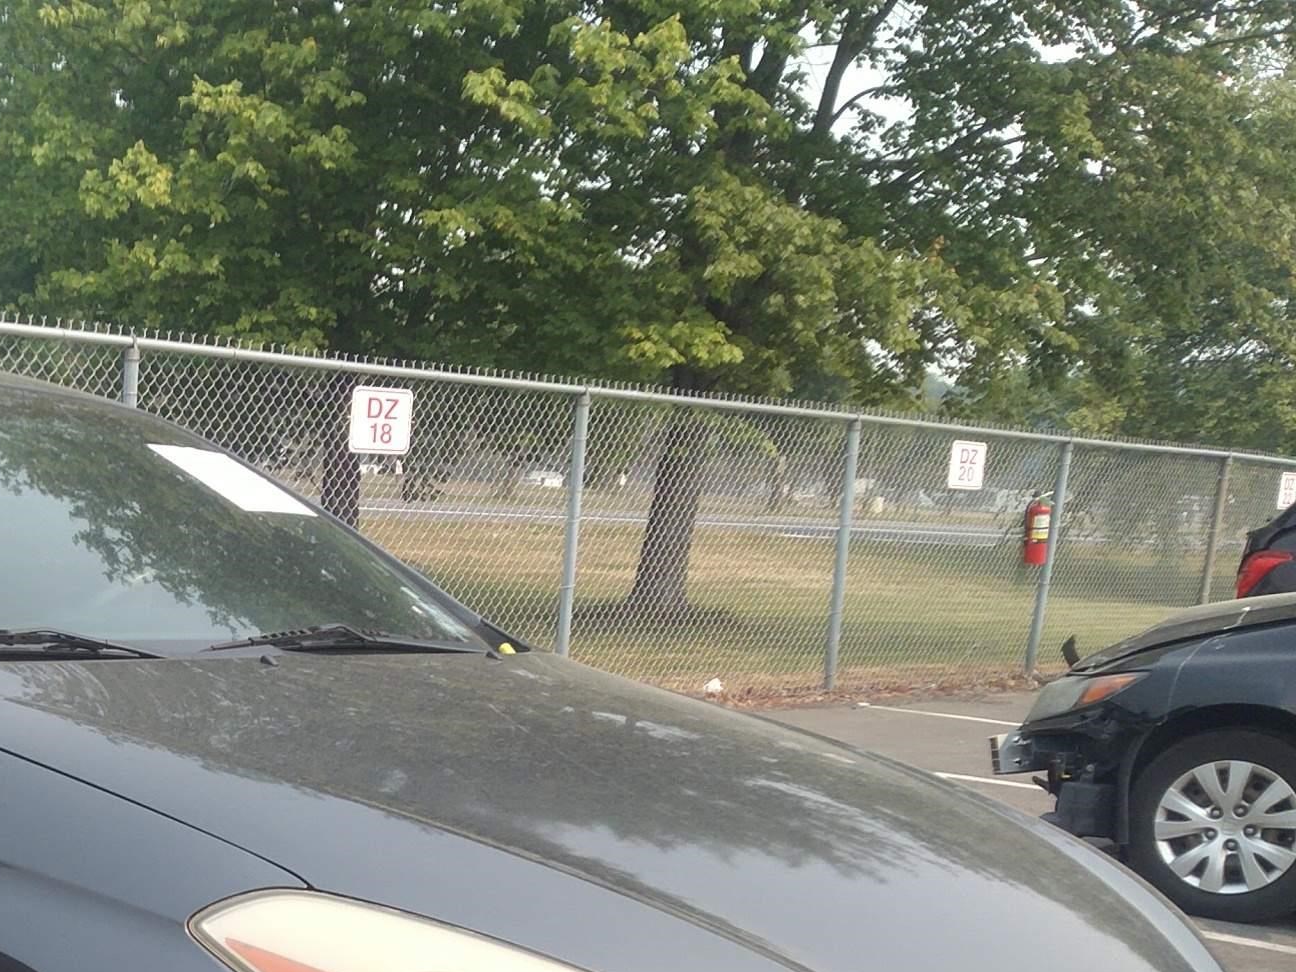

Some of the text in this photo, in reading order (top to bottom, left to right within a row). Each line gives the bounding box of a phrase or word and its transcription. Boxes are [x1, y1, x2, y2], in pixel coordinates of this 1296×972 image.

[367, 397, 400, 420] DZ
[370, 423, 392, 444] 18
[960, 448, 978, 465] DZ
[958, 465, 975, 482] 20
